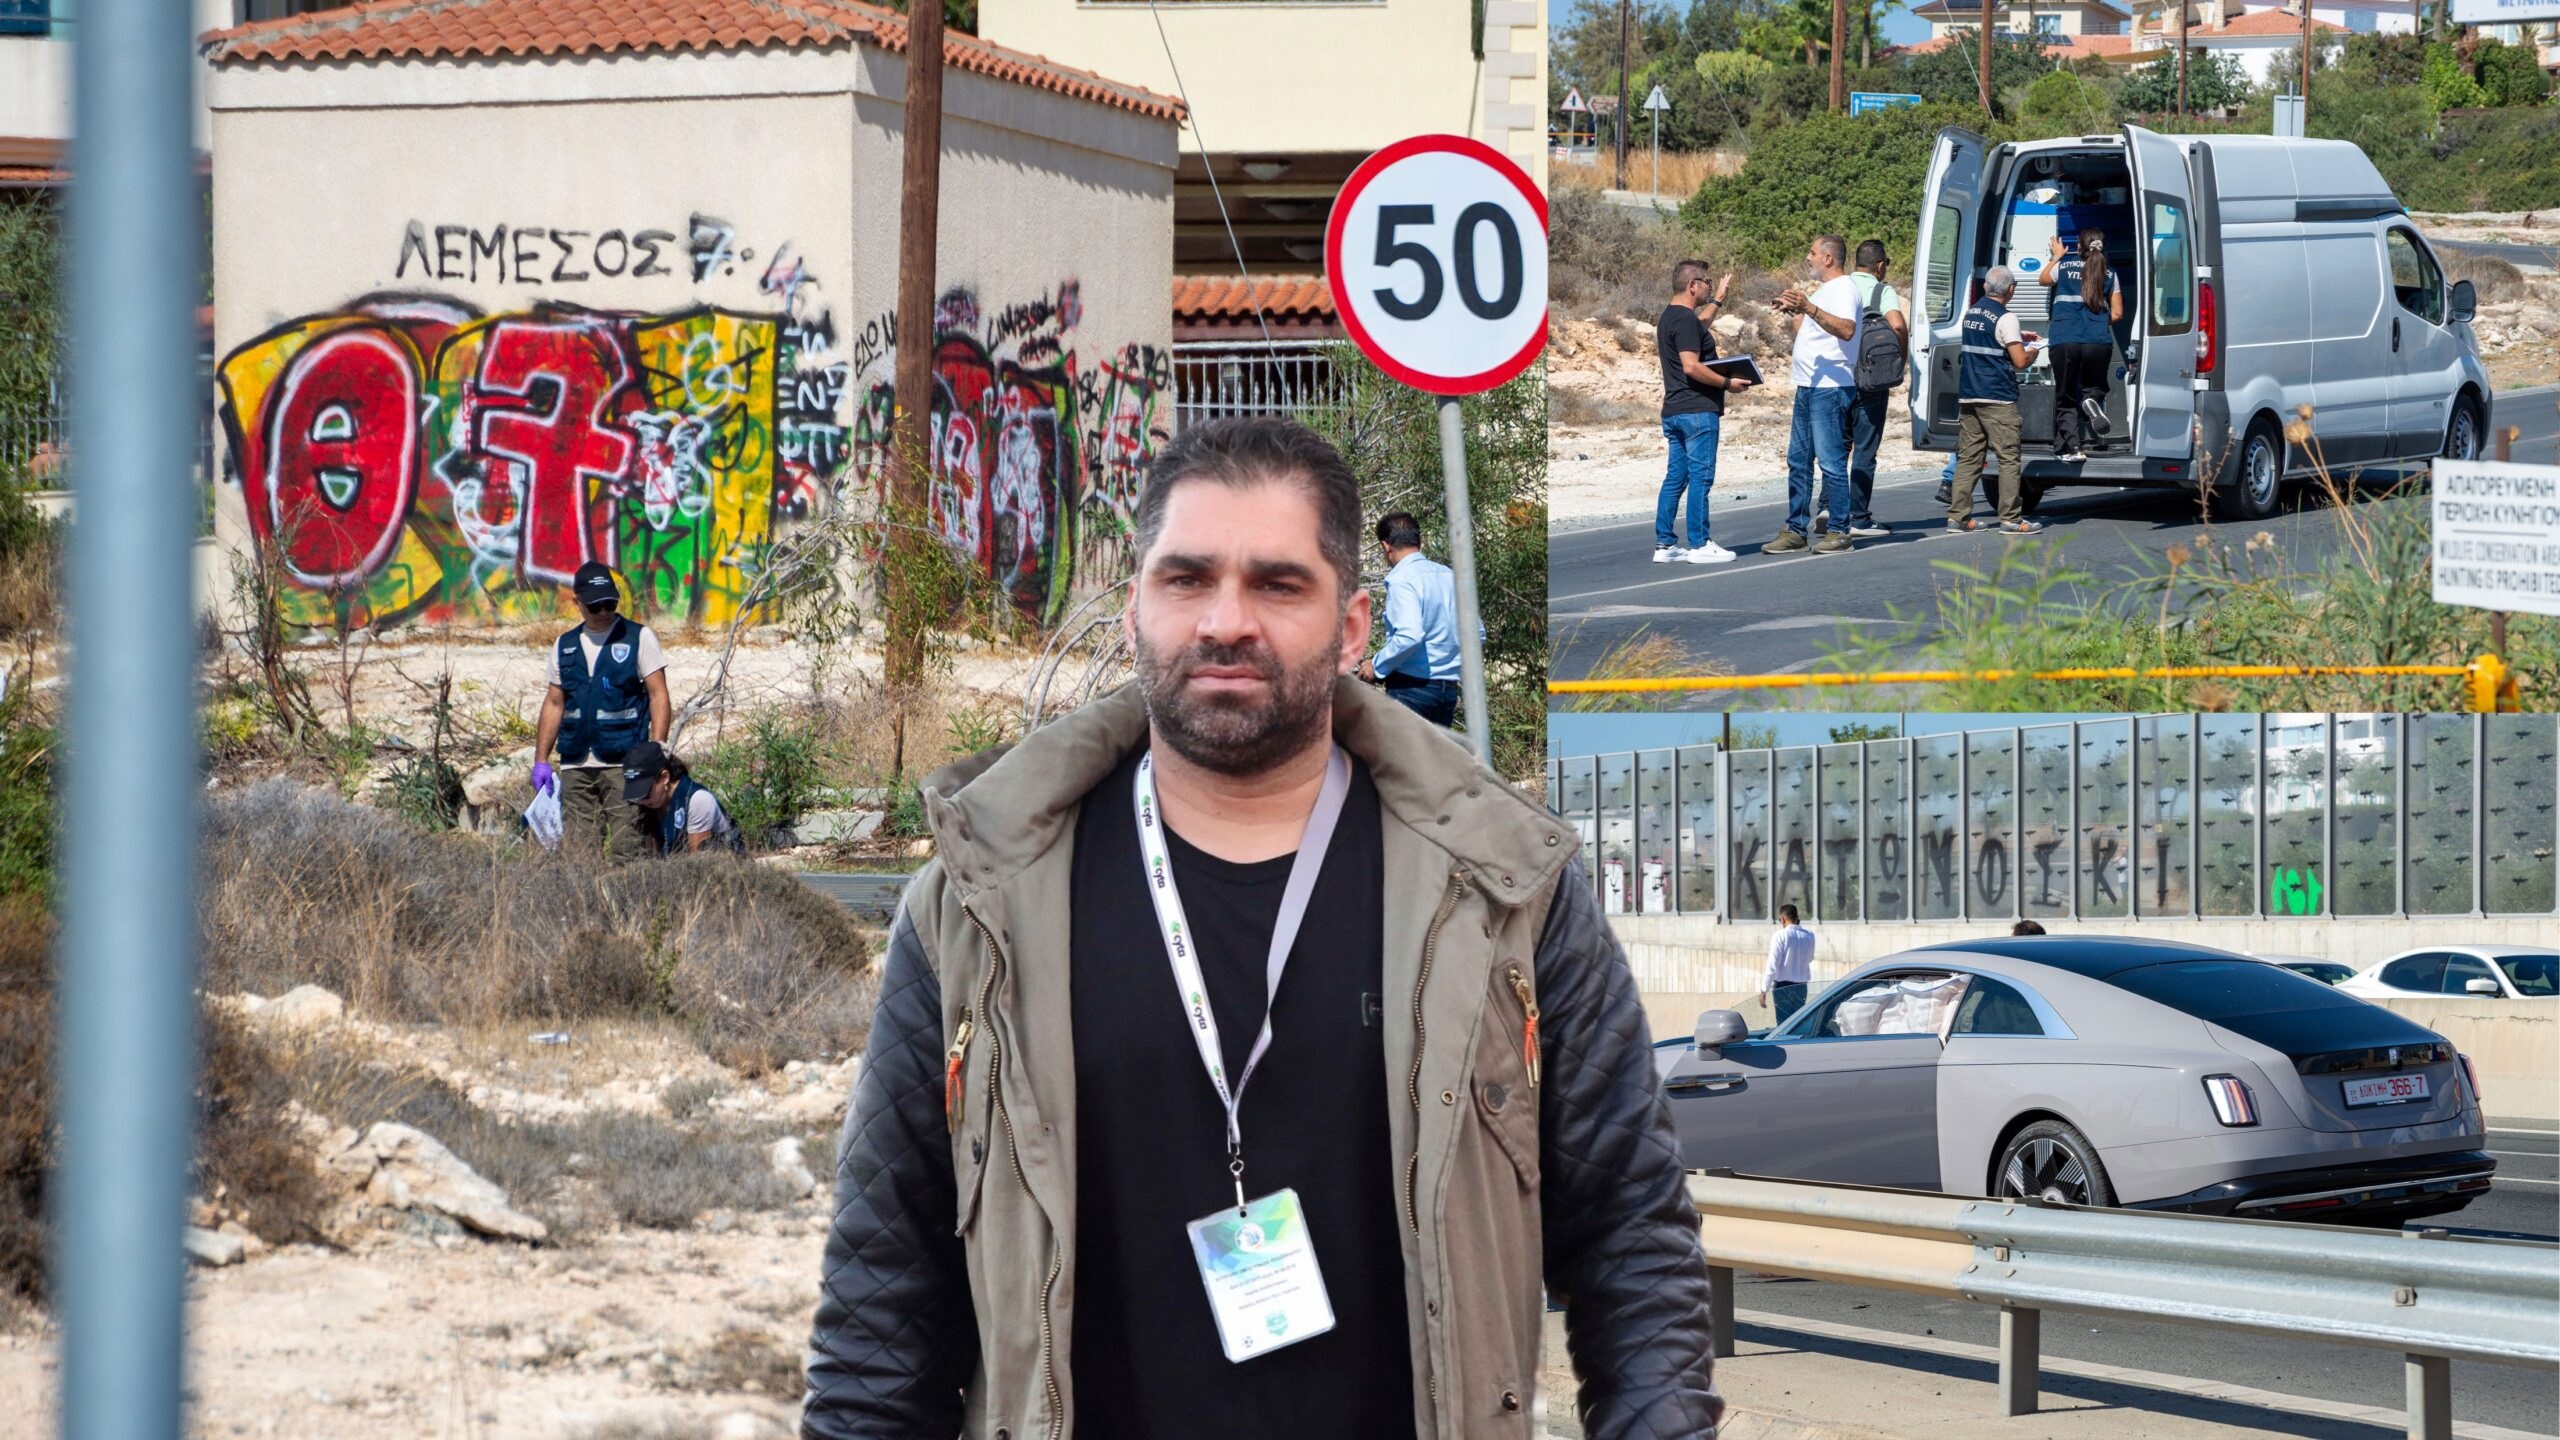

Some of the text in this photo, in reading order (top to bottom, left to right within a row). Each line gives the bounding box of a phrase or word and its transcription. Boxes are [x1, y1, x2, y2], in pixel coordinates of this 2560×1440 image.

[396, 219, 676, 285] ΛΕΜΕΣΟΣ
[1373, 201, 1524, 321] 50
[2438, 502, 2491, 523] ΠΕΡΙΟΧΗ
[2438, 565, 2483, 588] HUNTING
[1141, 807, 1153, 827] cyta
[1153, 868, 1166, 888] cyta
[1172, 935, 1186, 957] cyta
[1193, 1006, 1208, 1030] cyta
[2388, 1076, 2423, 1096] 366-7
